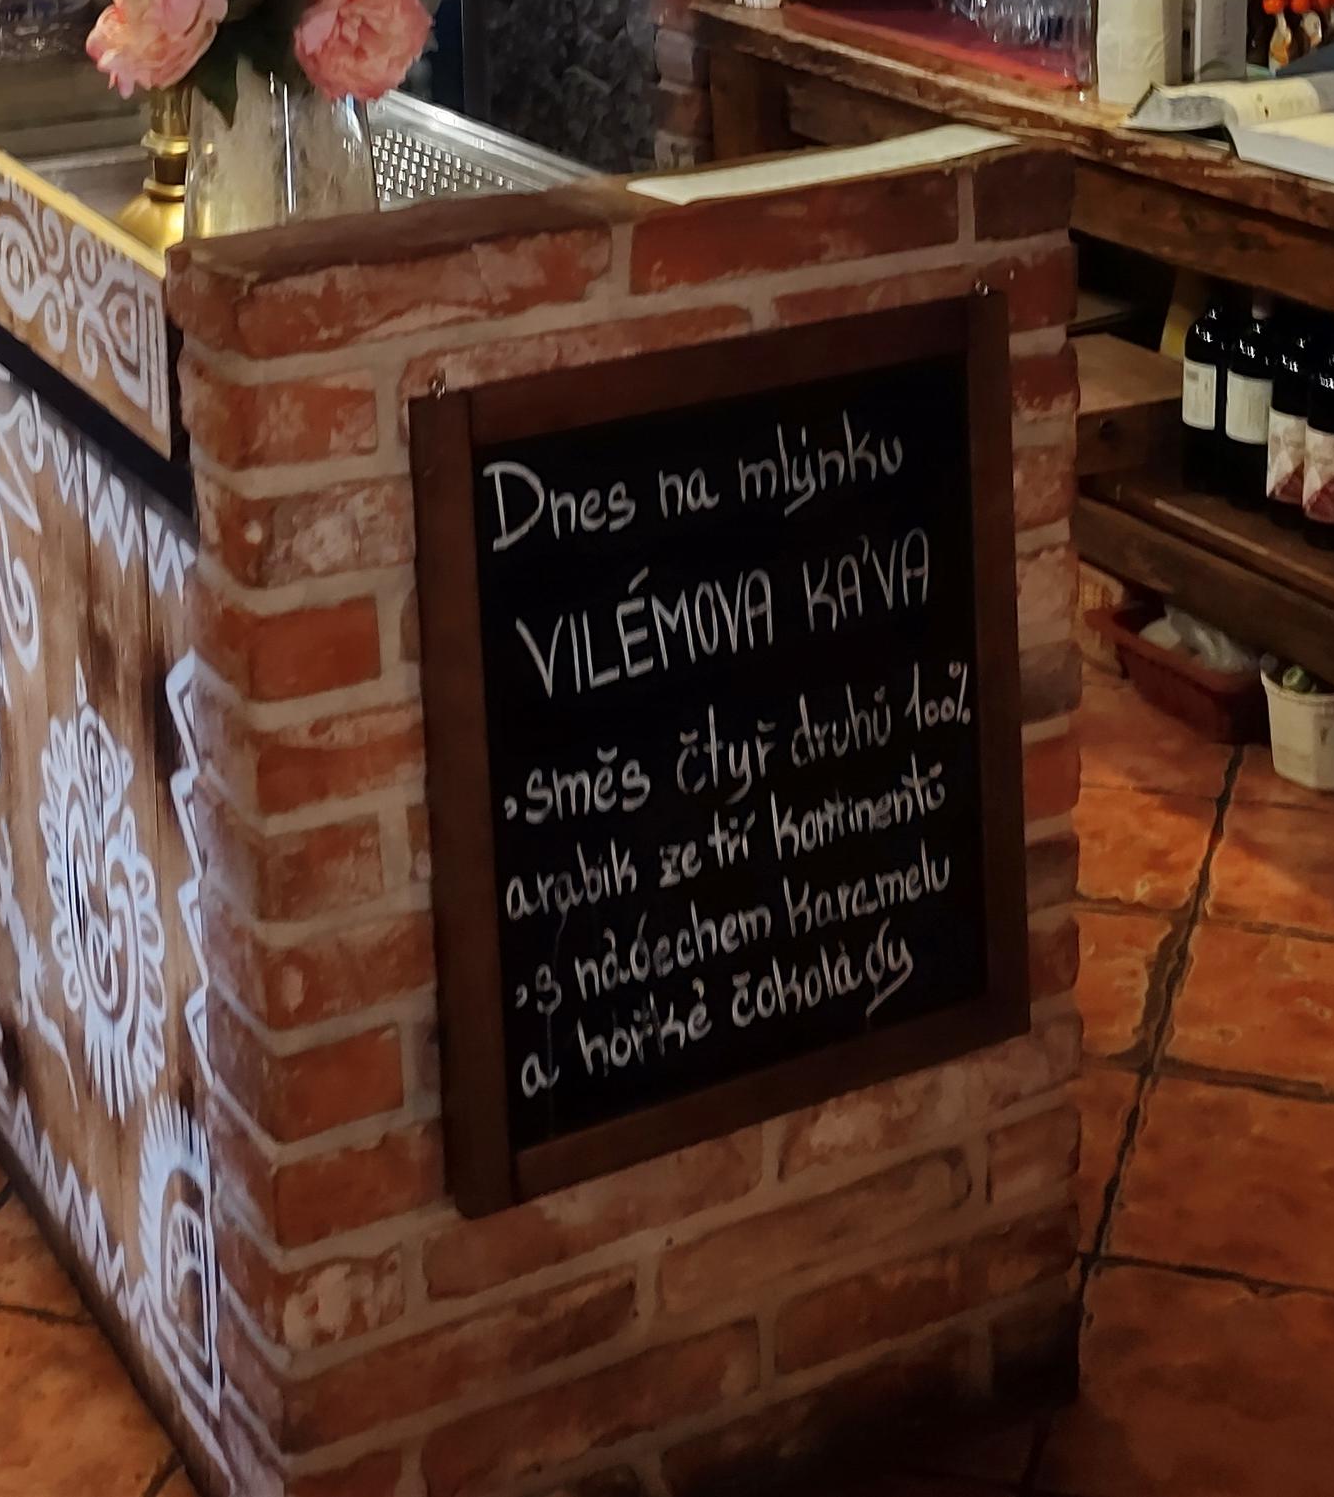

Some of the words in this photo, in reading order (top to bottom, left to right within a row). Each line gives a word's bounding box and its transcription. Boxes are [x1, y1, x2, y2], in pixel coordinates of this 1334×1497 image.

[482, 460, 636, 552] Dnes
[658, 467, 719, 519] na
[739, 409, 903, 517] mlýnku
[516, 566, 773, 698] VILÉMOVA
[676, 704, 776, 805] čtyř
[792, 682, 891, 767] druhů
[904, 660, 971, 732] 100%
[506, 837, 638, 921] arabik
[658, 840, 702, 889] ze
[707, 809, 756, 869] tří
[521, 1051, 560, 1099] a
[578, 977, 713, 1077] hořké
[731, 918, 913, 1028] čokolády
[575, 900, 771, 1001] nádechem
